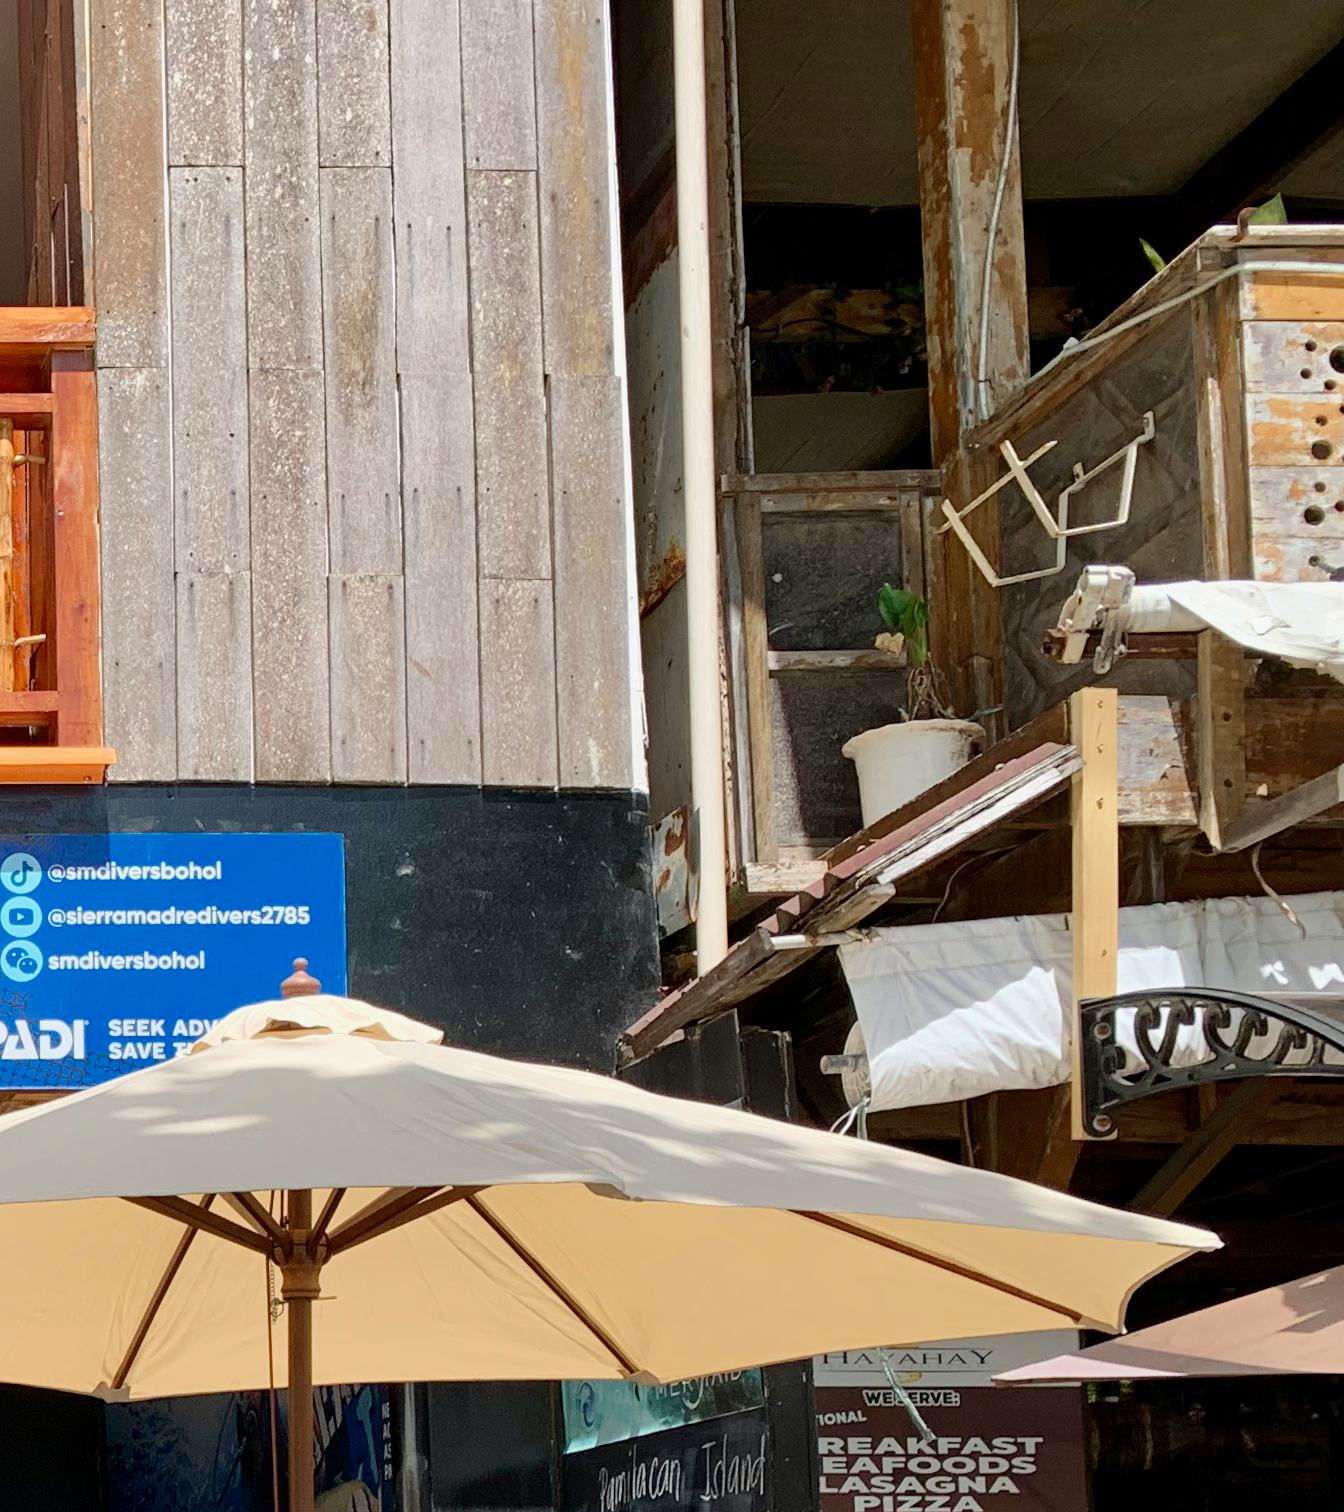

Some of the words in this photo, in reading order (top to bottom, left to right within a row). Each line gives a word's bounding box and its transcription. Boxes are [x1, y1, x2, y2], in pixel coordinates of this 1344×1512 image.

[47, 861, 221, 883] @smdiversbohol
[47, 905, 310, 927] @sierramadredivers2785
[48, 950, 205, 971] smdiversbohol
[108, 1019, 166, 1037] SEEK
[172, 1019, 223, 1037] ADV
[108, 1042, 166, 1060] SAVE
[863, 1390, 894, 1406] WE
[818, 1437, 1044, 1454] REAKFAST
[701, 1433, 765, 1501] Island
[822, 1456, 1037, 1474] EAFOODS
[819, 1476, 1020, 1493] LASAGNA
[854, 1495, 984, 1512] PIZZA
